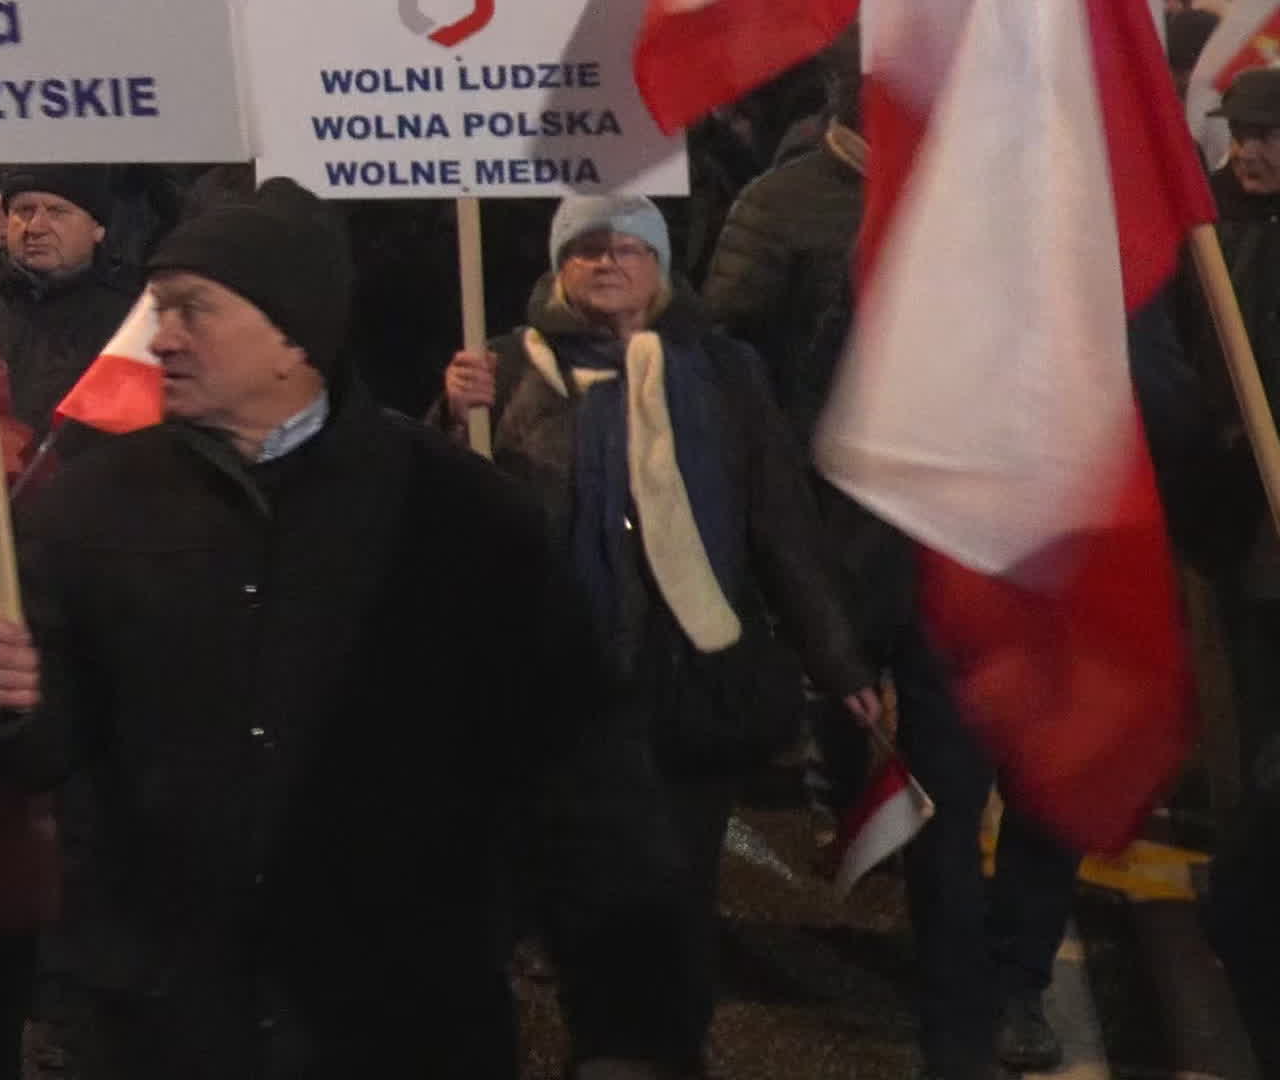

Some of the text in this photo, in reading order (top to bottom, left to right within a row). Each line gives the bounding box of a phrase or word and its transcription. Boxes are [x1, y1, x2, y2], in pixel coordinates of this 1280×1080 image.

[320, 64, 601, 94] WOLNI LUDZIE
[312, 110, 623, 141] WOLNA POLSKA
[325, 158, 601, 186] WOLNE MEDIA
